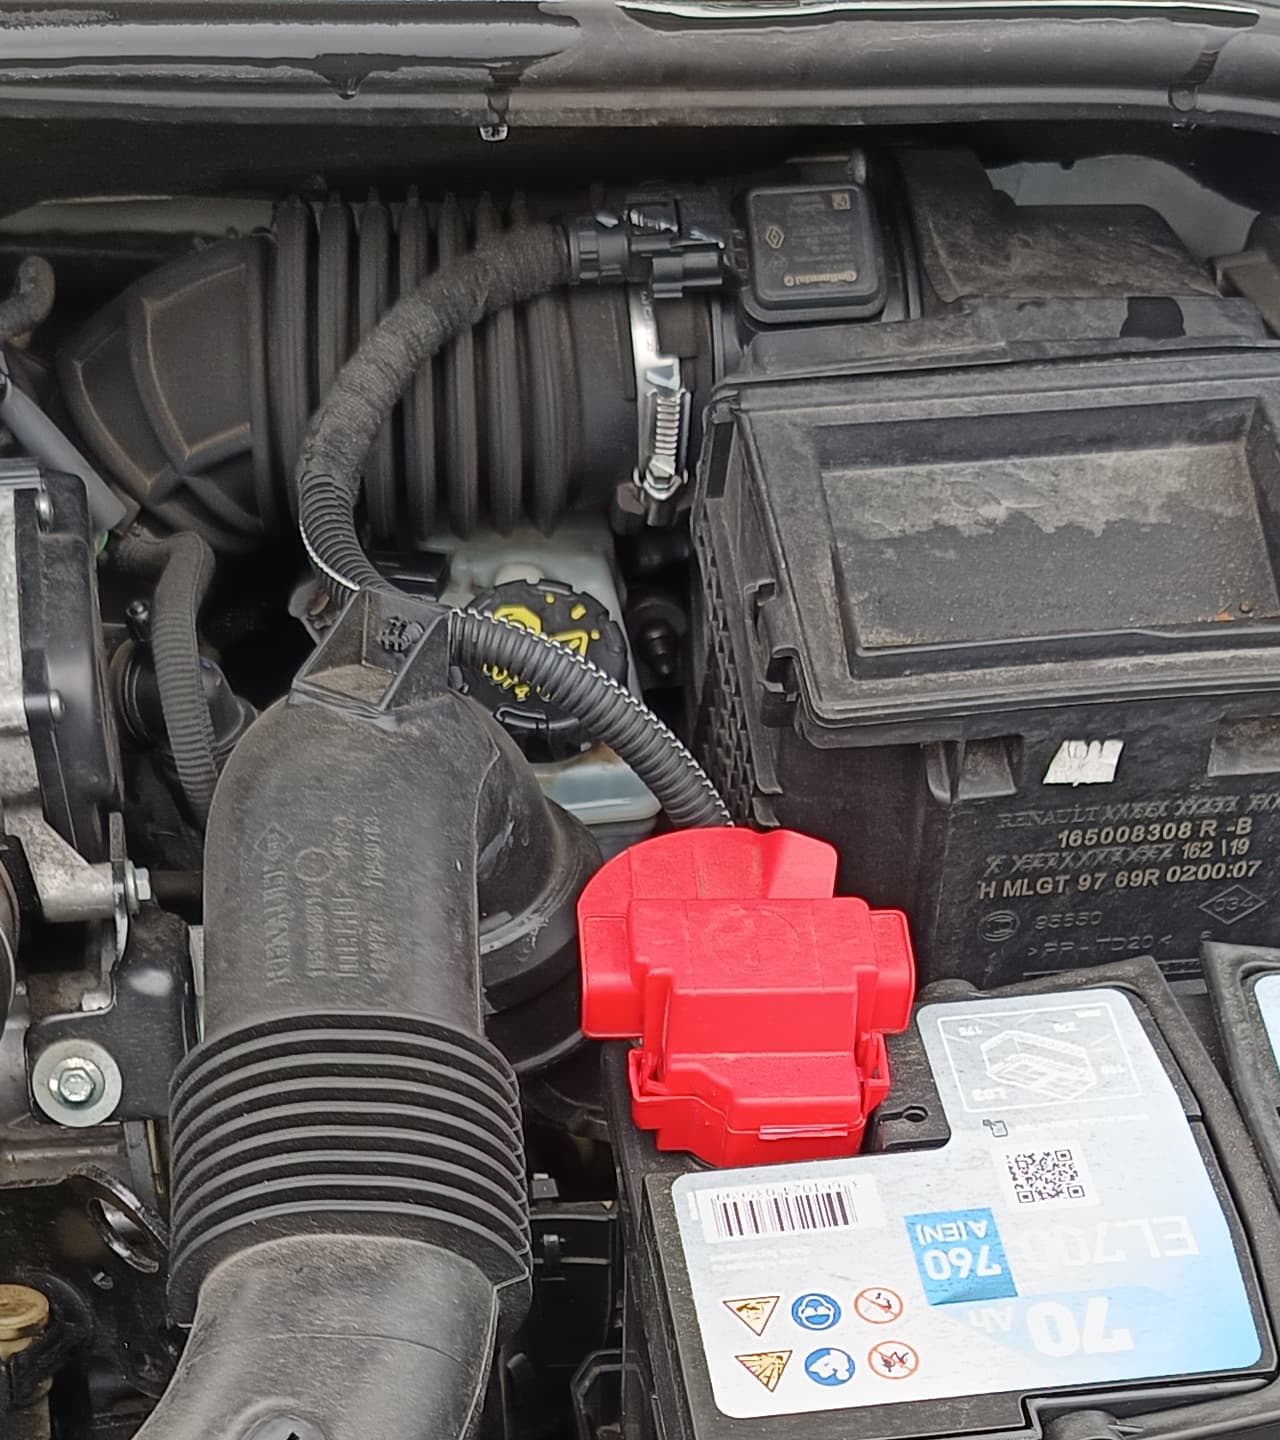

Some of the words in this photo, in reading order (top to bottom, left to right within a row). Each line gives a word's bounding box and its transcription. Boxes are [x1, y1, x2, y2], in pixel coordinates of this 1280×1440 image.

[1057, 822, 1193, 849] 165008308
[1199, 819, 1217, 838] R
[1181, 839, 1212, 861] 162
[1001, 876, 1072, 899] MLGT
[1076, 871, 1107, 892] 97
[923, 1245, 1003, 1281] 760
[1026, 1297, 1136, 1357] 70
